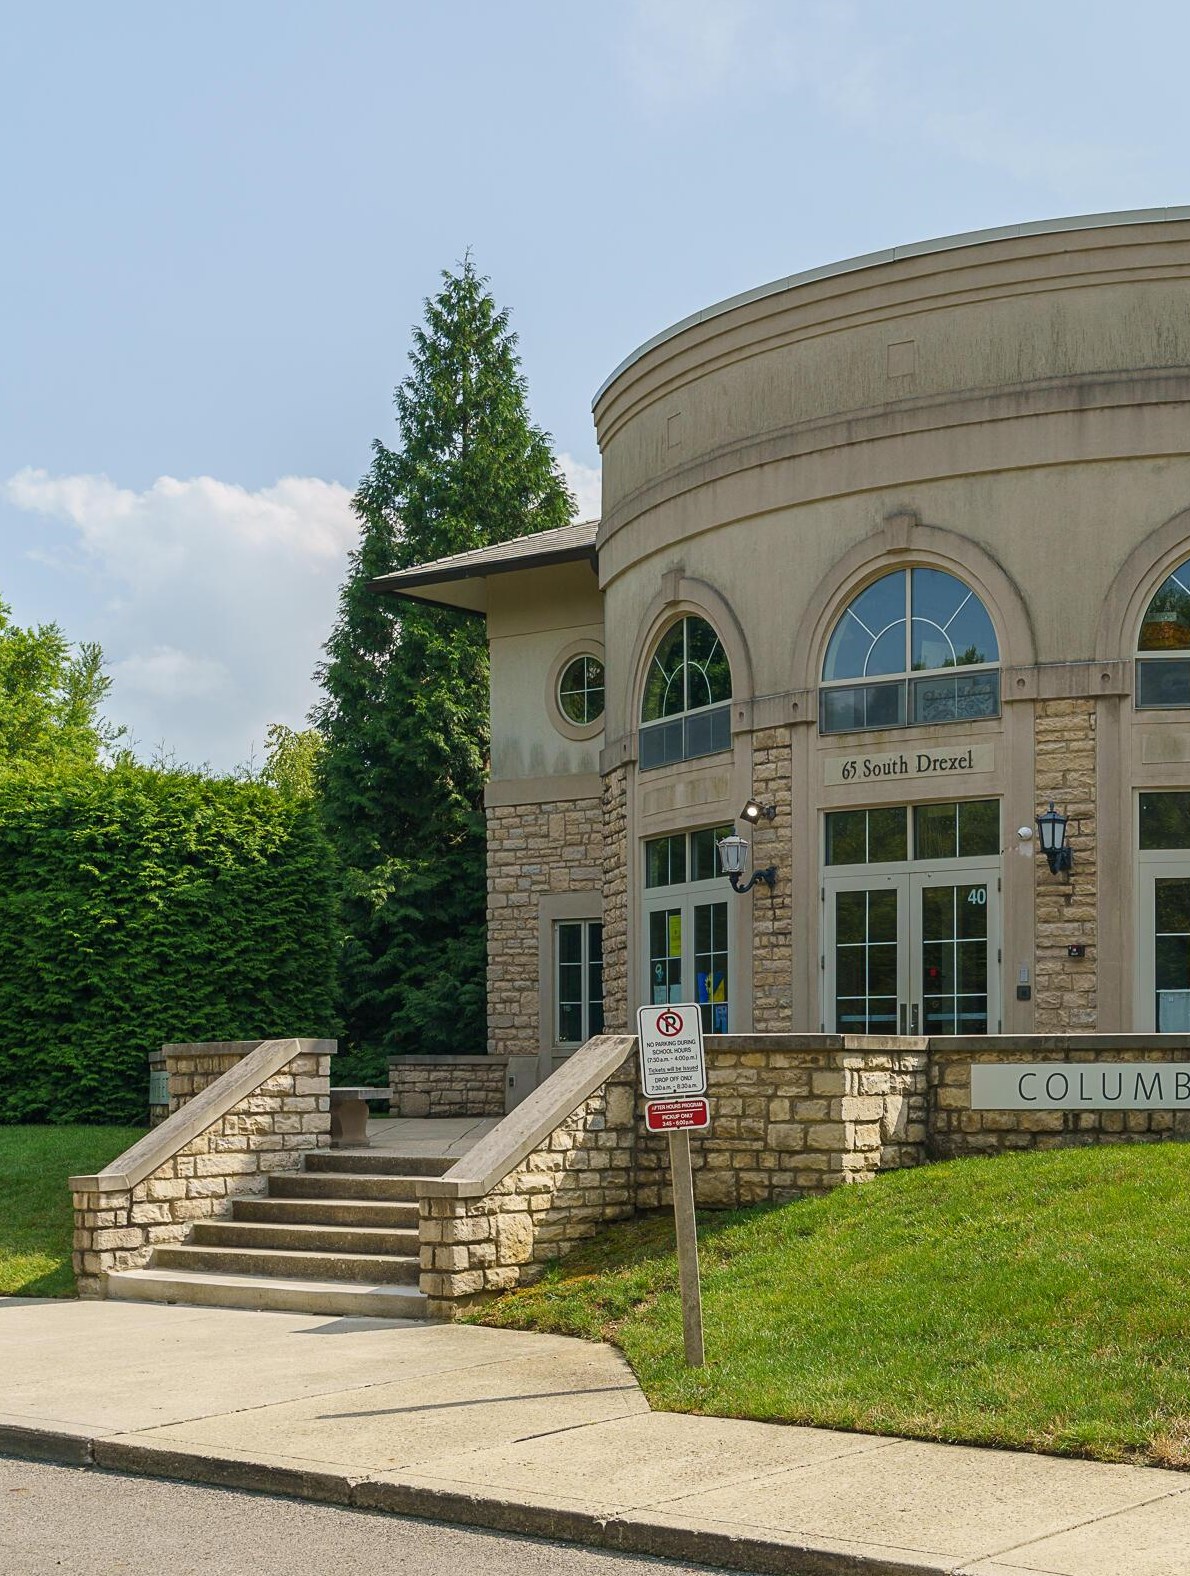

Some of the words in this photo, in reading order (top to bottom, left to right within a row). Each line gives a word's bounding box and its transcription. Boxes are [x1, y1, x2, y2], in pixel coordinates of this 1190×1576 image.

[842, 761, 857, 780] 65
[863, 755, 908, 778] South
[916, 750, 974, 773] Drexel
[968, 889, 986, 905] 40
